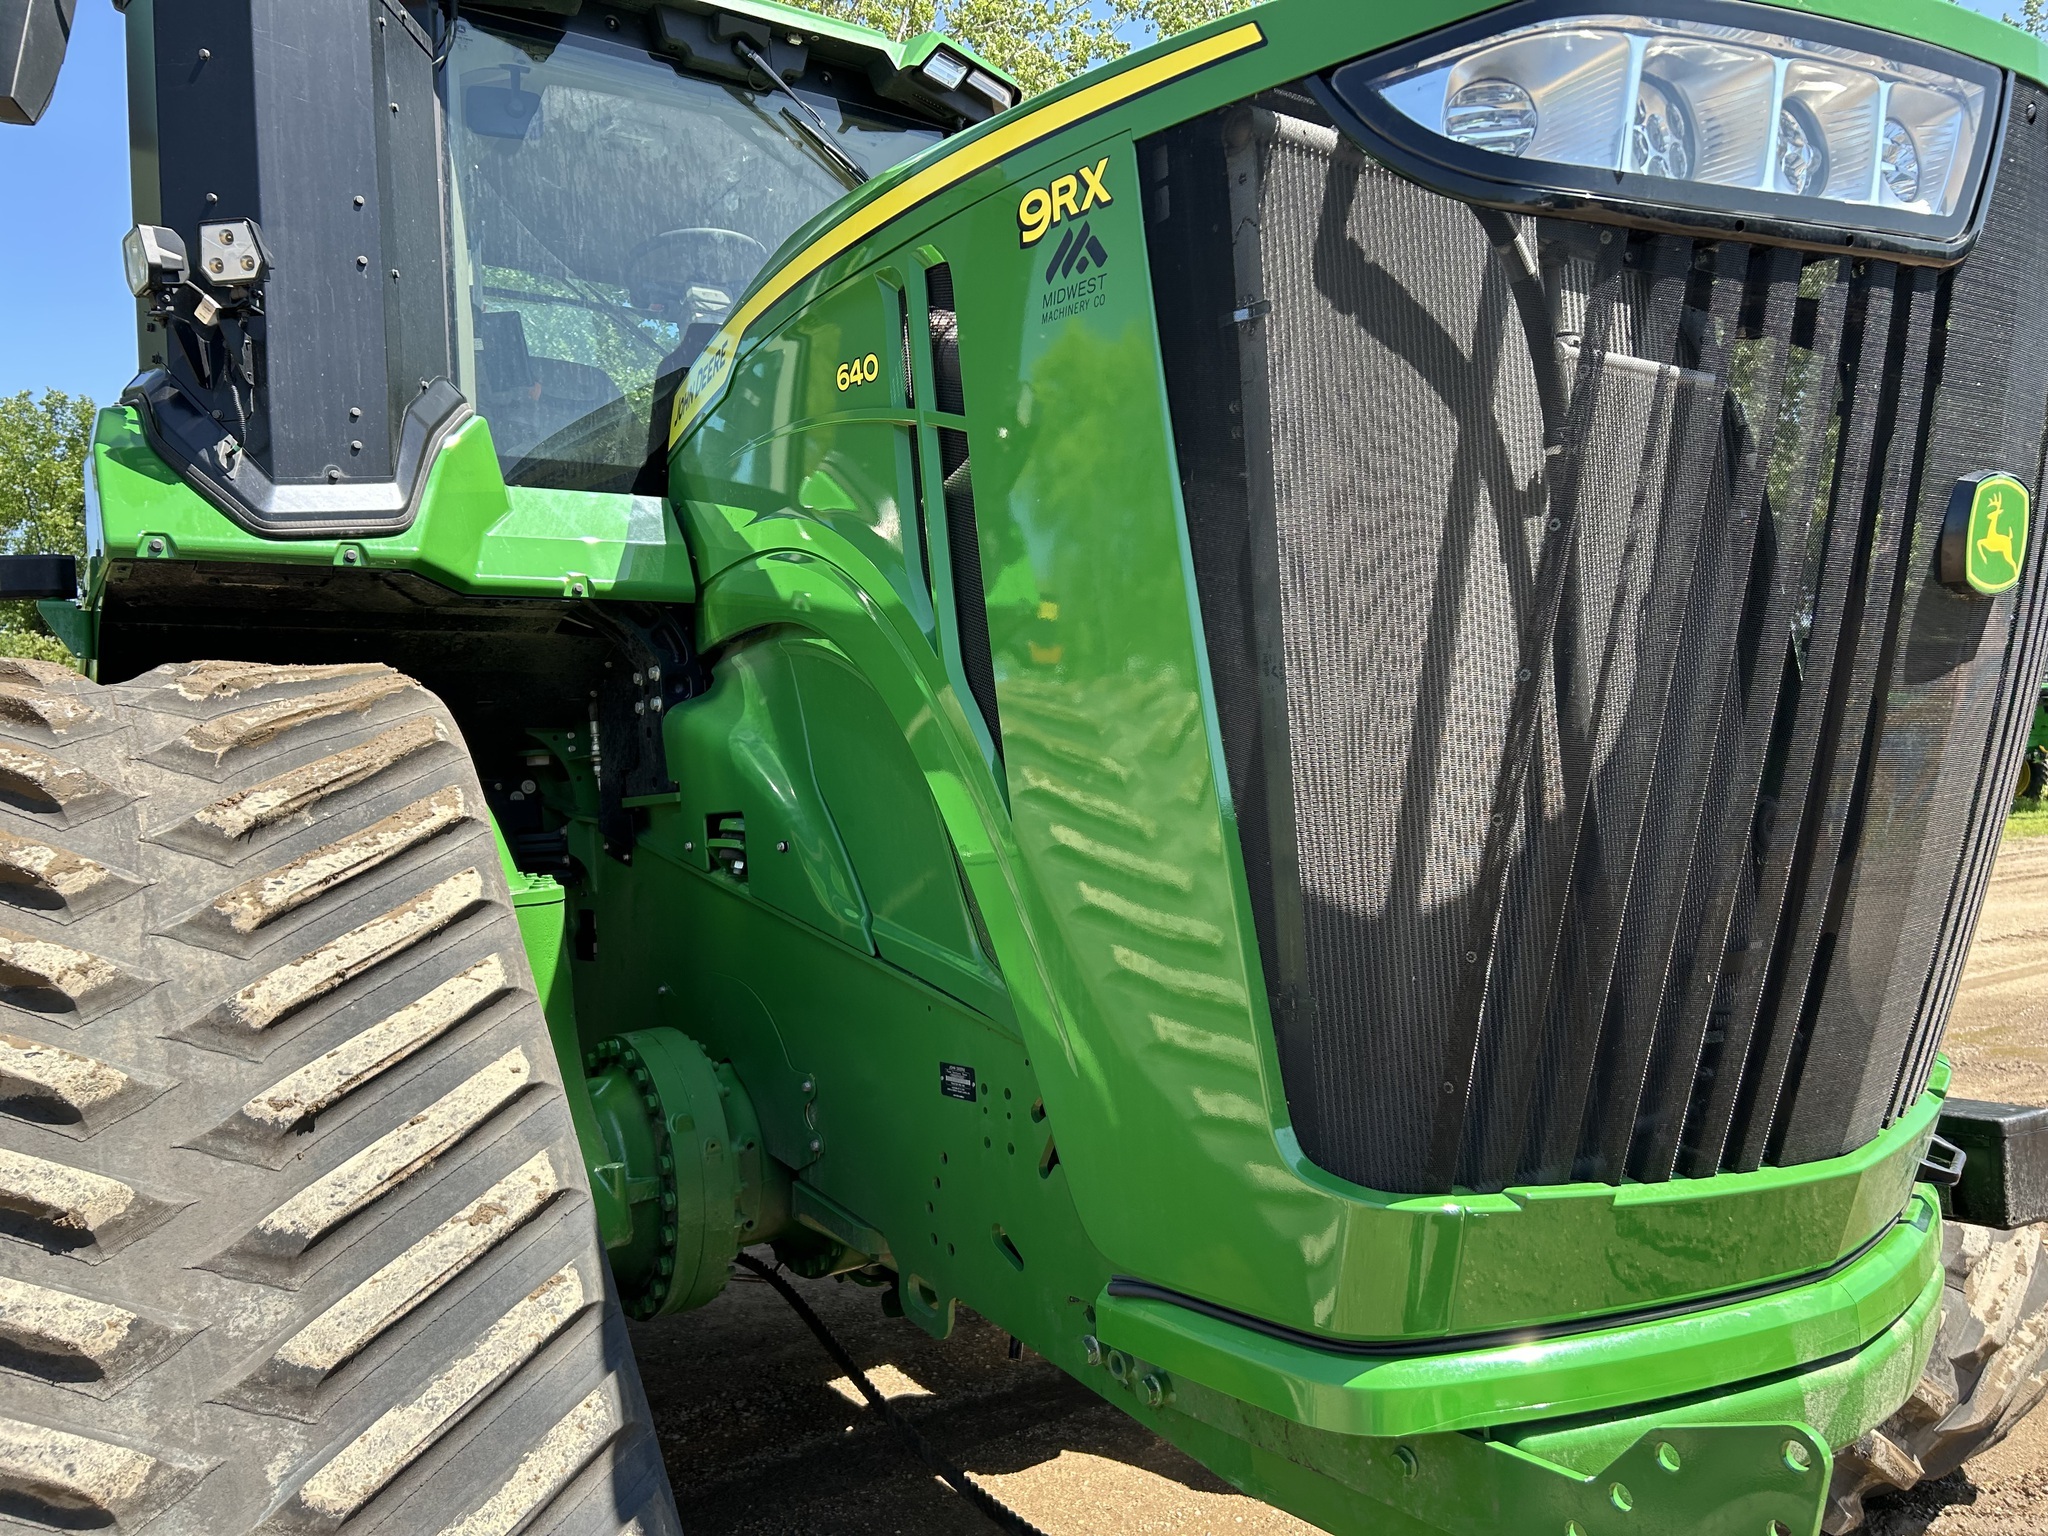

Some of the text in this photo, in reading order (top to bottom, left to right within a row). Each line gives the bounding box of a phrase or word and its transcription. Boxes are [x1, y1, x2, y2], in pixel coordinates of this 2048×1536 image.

[1017, 155, 1114, 249] 9RX
[1041, 293, 1106, 325] MACHINERY CO
[1042, 273, 1107, 309] MIDWEST
[674, 339, 728, 427] JOHN DEERE
[836, 352, 879, 391] 640
